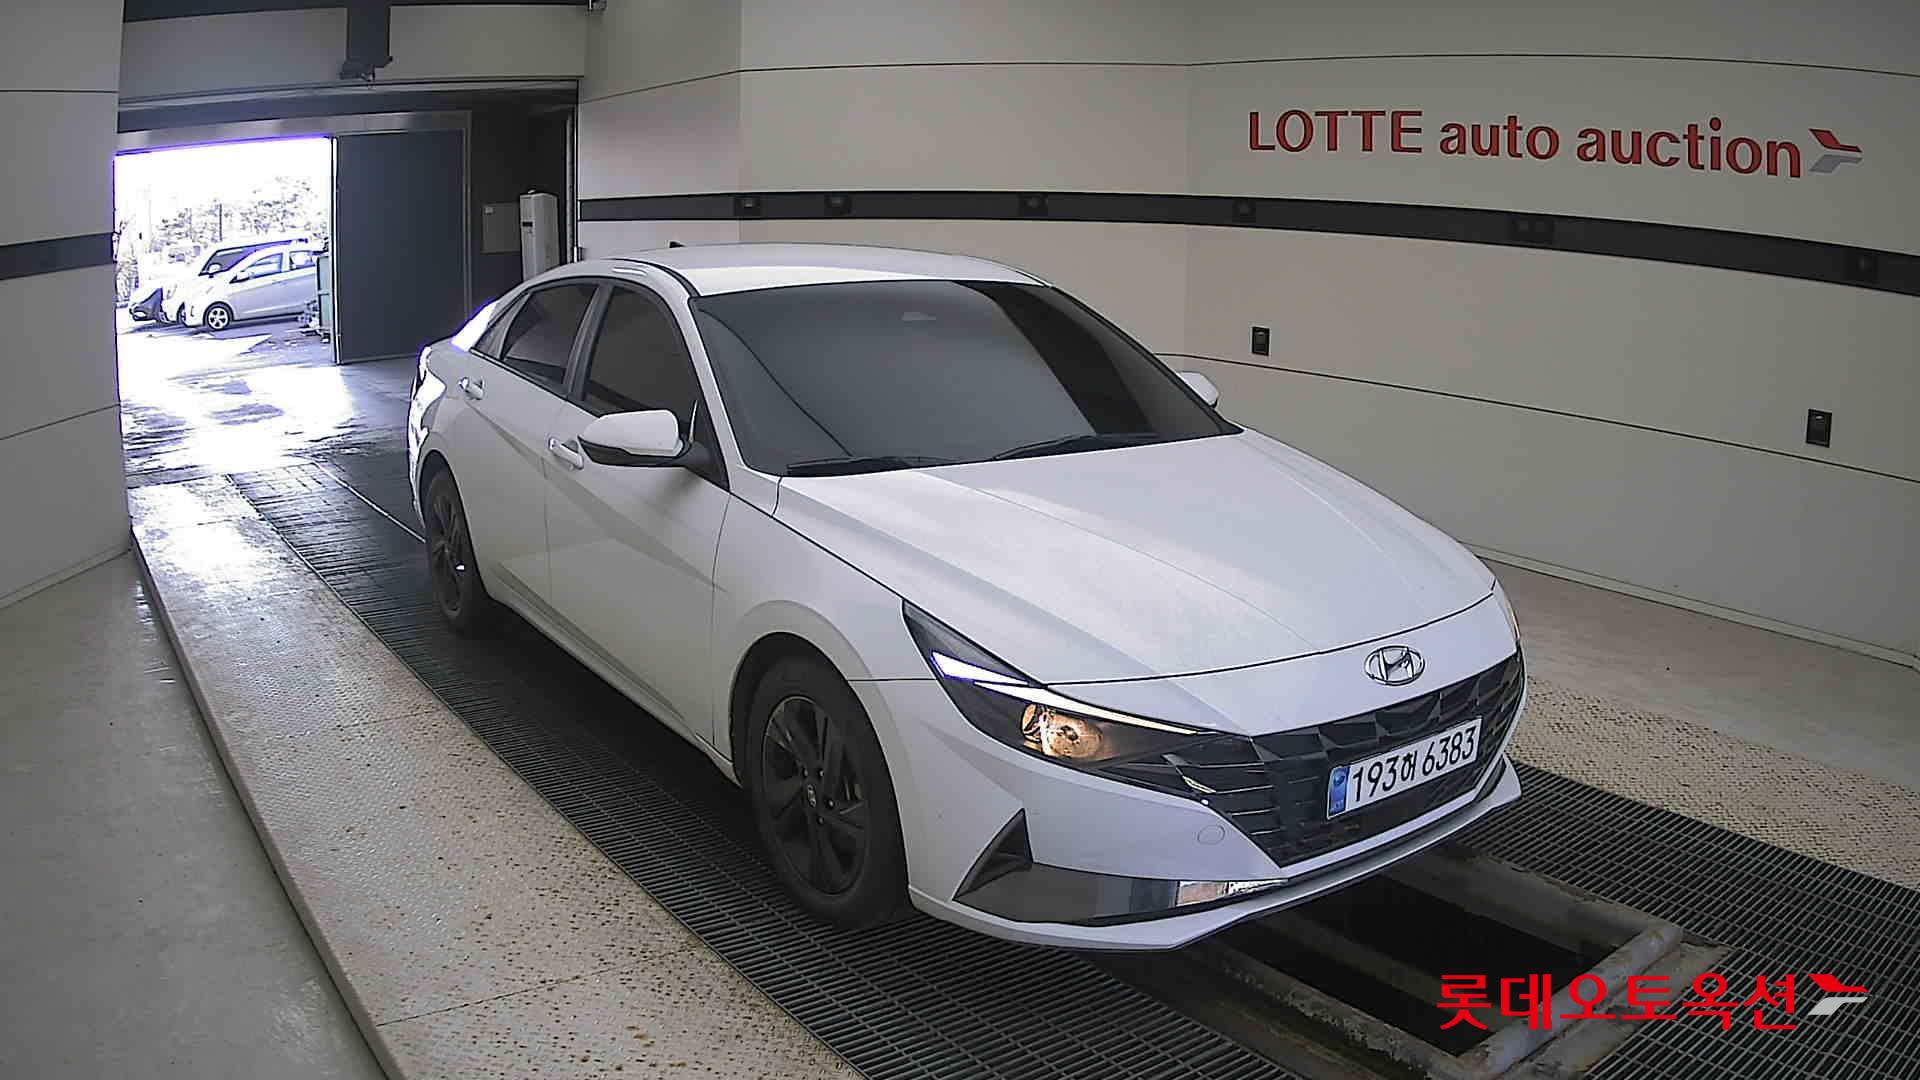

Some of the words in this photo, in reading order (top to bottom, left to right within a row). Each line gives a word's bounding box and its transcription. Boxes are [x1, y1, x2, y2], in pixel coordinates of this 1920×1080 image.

[1249, 110, 1423, 153] LOTTE
[1440, 115, 1560, 160] auto
[1576, 116, 1801, 178] auction
[1422, 726, 1476, 776] 6383
